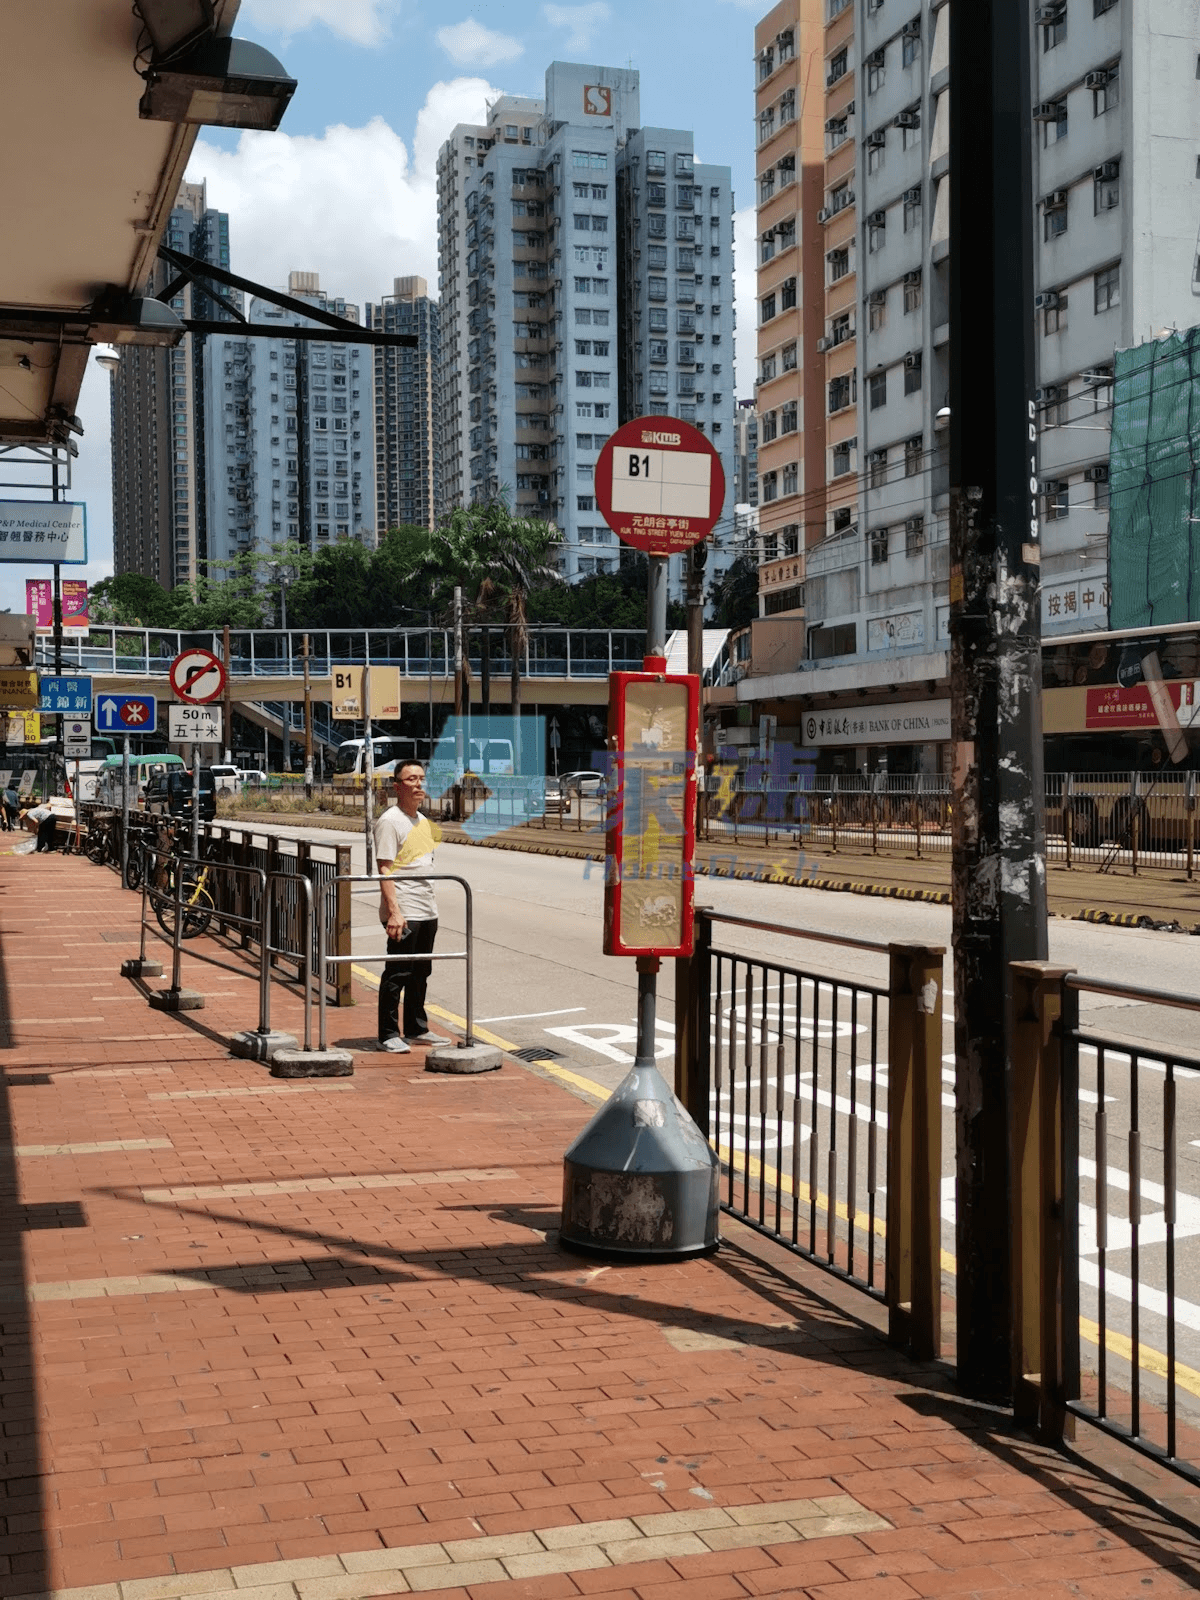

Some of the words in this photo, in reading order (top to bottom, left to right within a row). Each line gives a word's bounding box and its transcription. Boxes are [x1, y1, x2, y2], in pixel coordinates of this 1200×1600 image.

[652, 431, 681, 446] KMB
[629, 454, 650, 477] B1
[17, 520, 51, 528] Medical
[52, 520, 80, 528] Center
[632, 515, 690, 530] 元朗谷亭街
[647, 528, 668, 537] STREET
[669, 530, 684, 538] YUEN
[685, 531, 700, 539] LONG
[336, 673, 352, 688] B1
[182, 709, 199, 720] 50
[201, 712, 211, 720] m
[173, 723, 218, 738] 五十米
[869, 720, 889, 732] BANK
[891, 719, 902, 731] OF
[903, 717, 930, 730] CHINA
